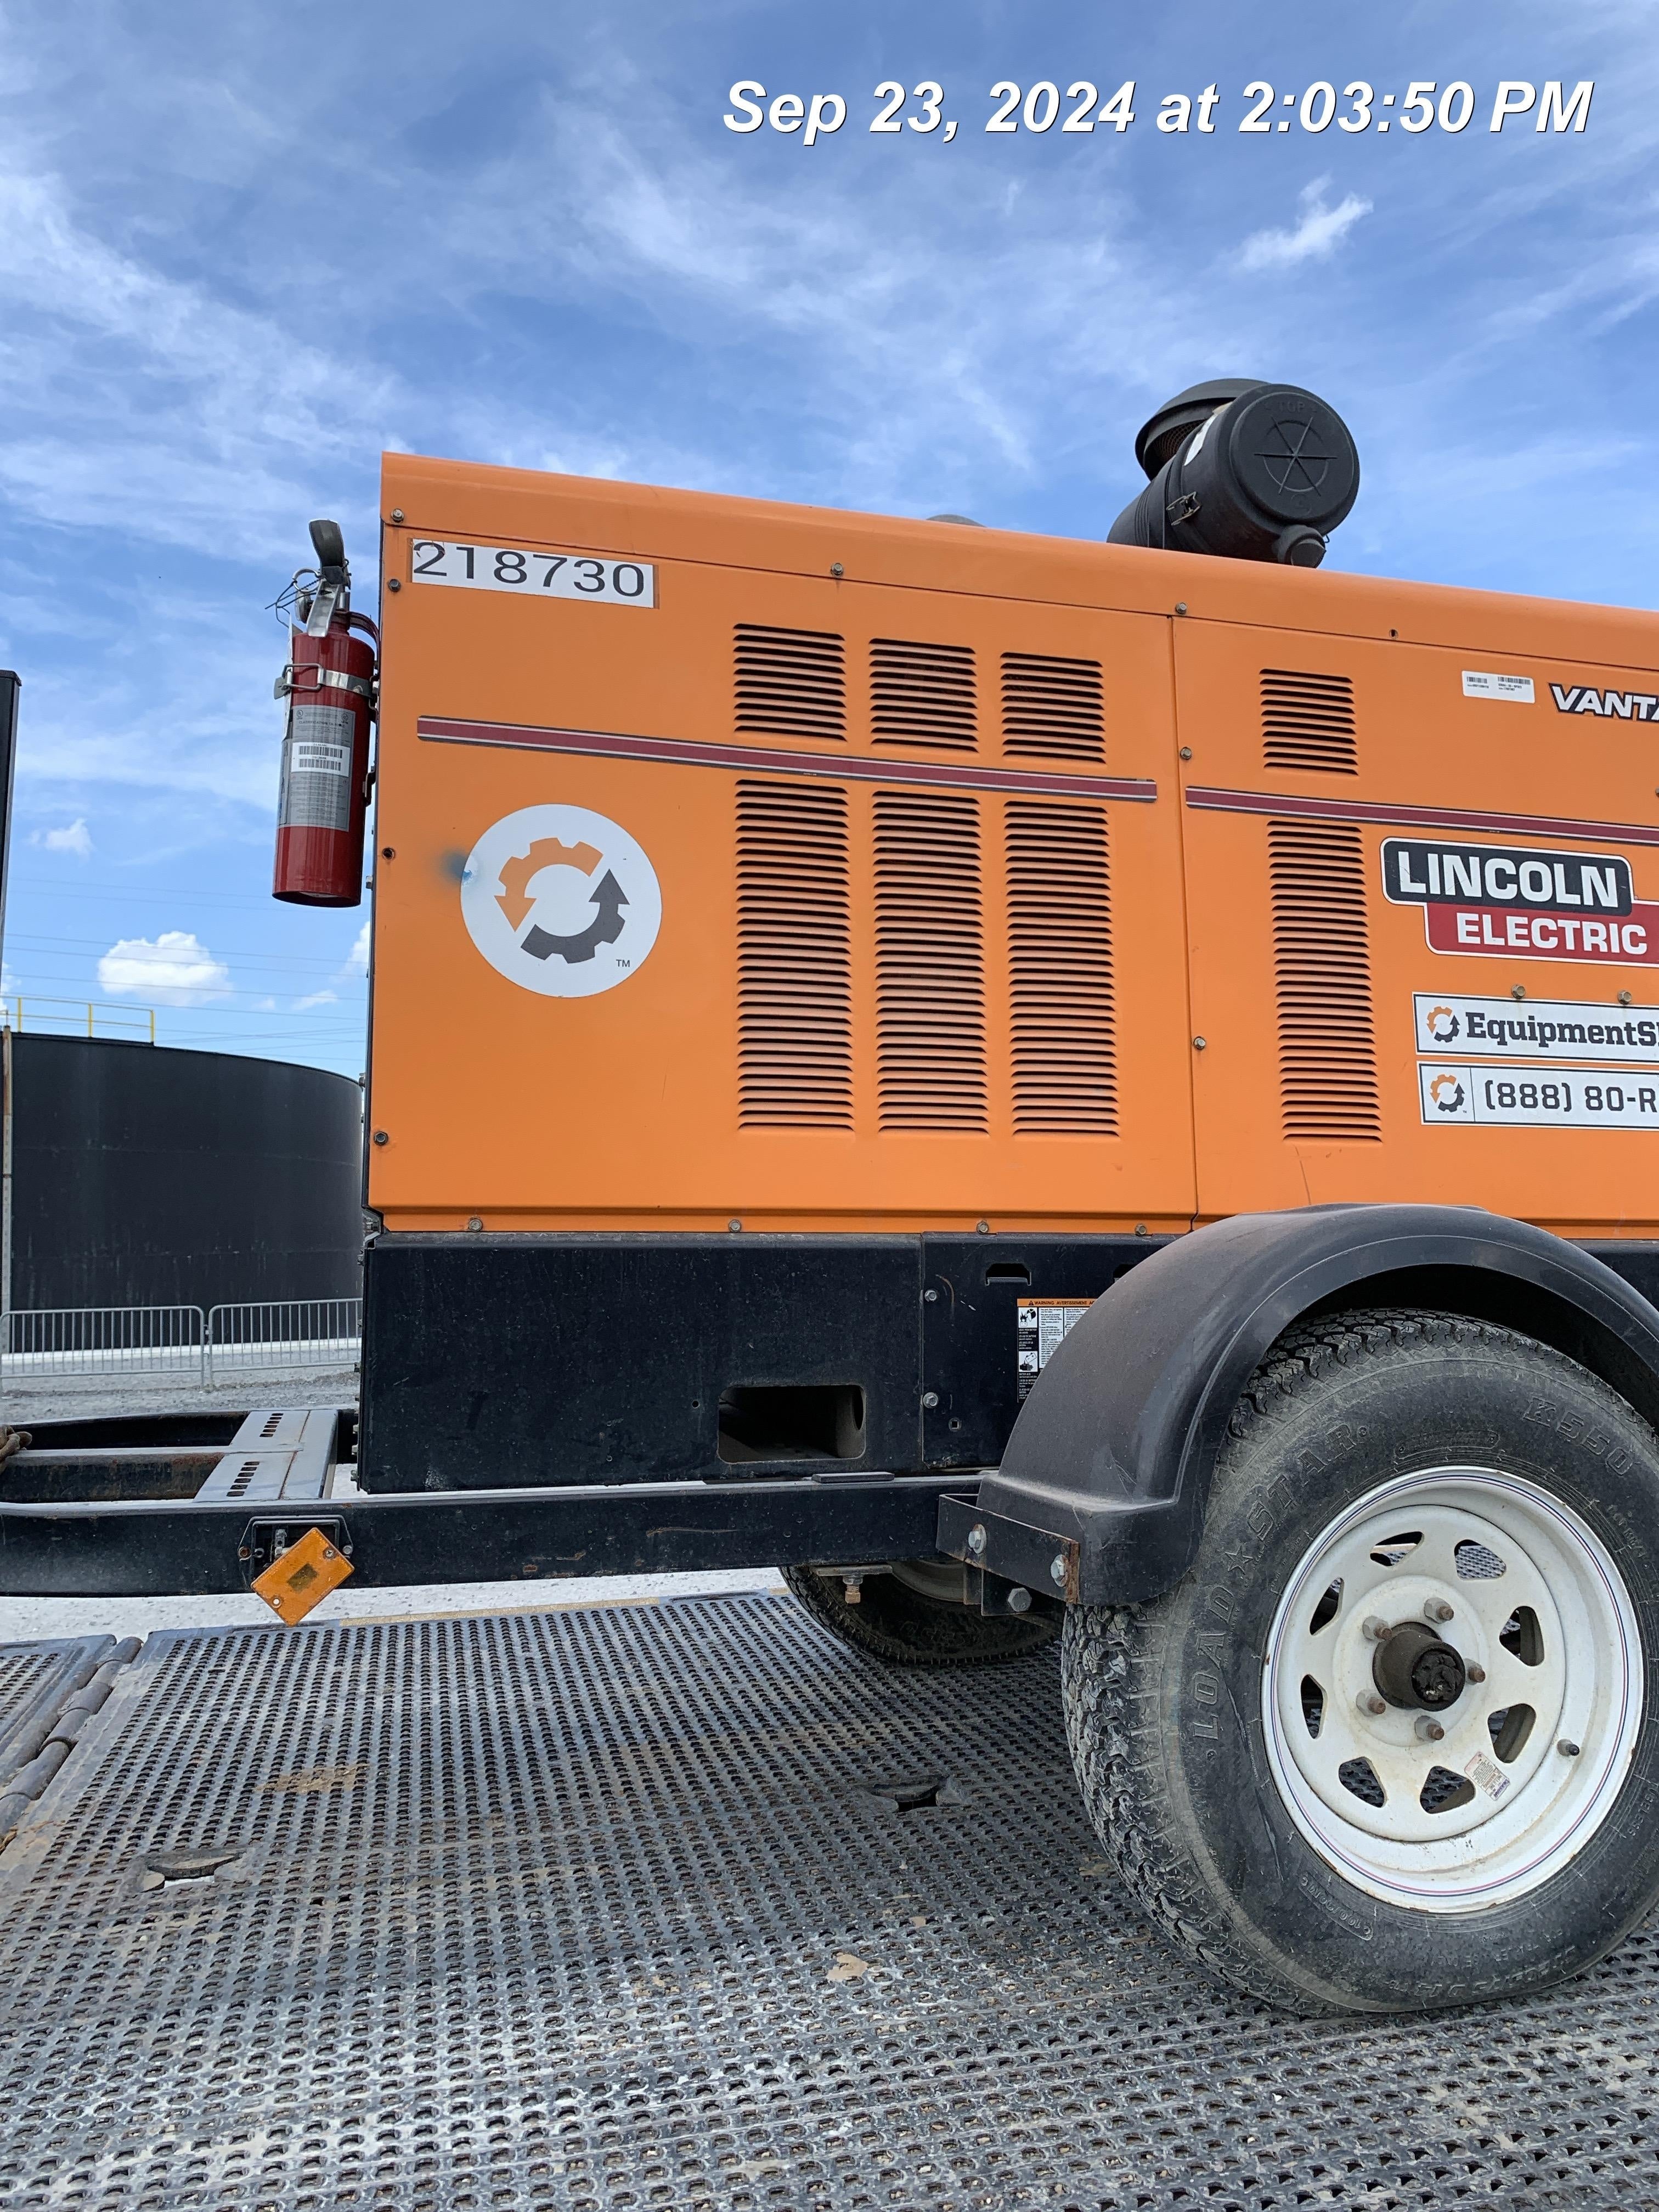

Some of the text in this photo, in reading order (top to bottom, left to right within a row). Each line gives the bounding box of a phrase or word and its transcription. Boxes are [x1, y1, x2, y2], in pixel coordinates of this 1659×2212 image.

[413, 540, 645, 597] 218730
[1398, 850, 1618, 908] LINCOLN
[1457, 912, 1648, 955] ELECTRIC
[616, 959, 631, 968] TM
[1465, 1011, 1659, 1048] EquipmentS
[1484, 1080, 1658, 1113] (888) 80-R
[1522, 1396, 1634, 1476] K550
[1192, 1585, 1235, 1740] LOAD
[1246, 1422, 1357, 1542] STAR
